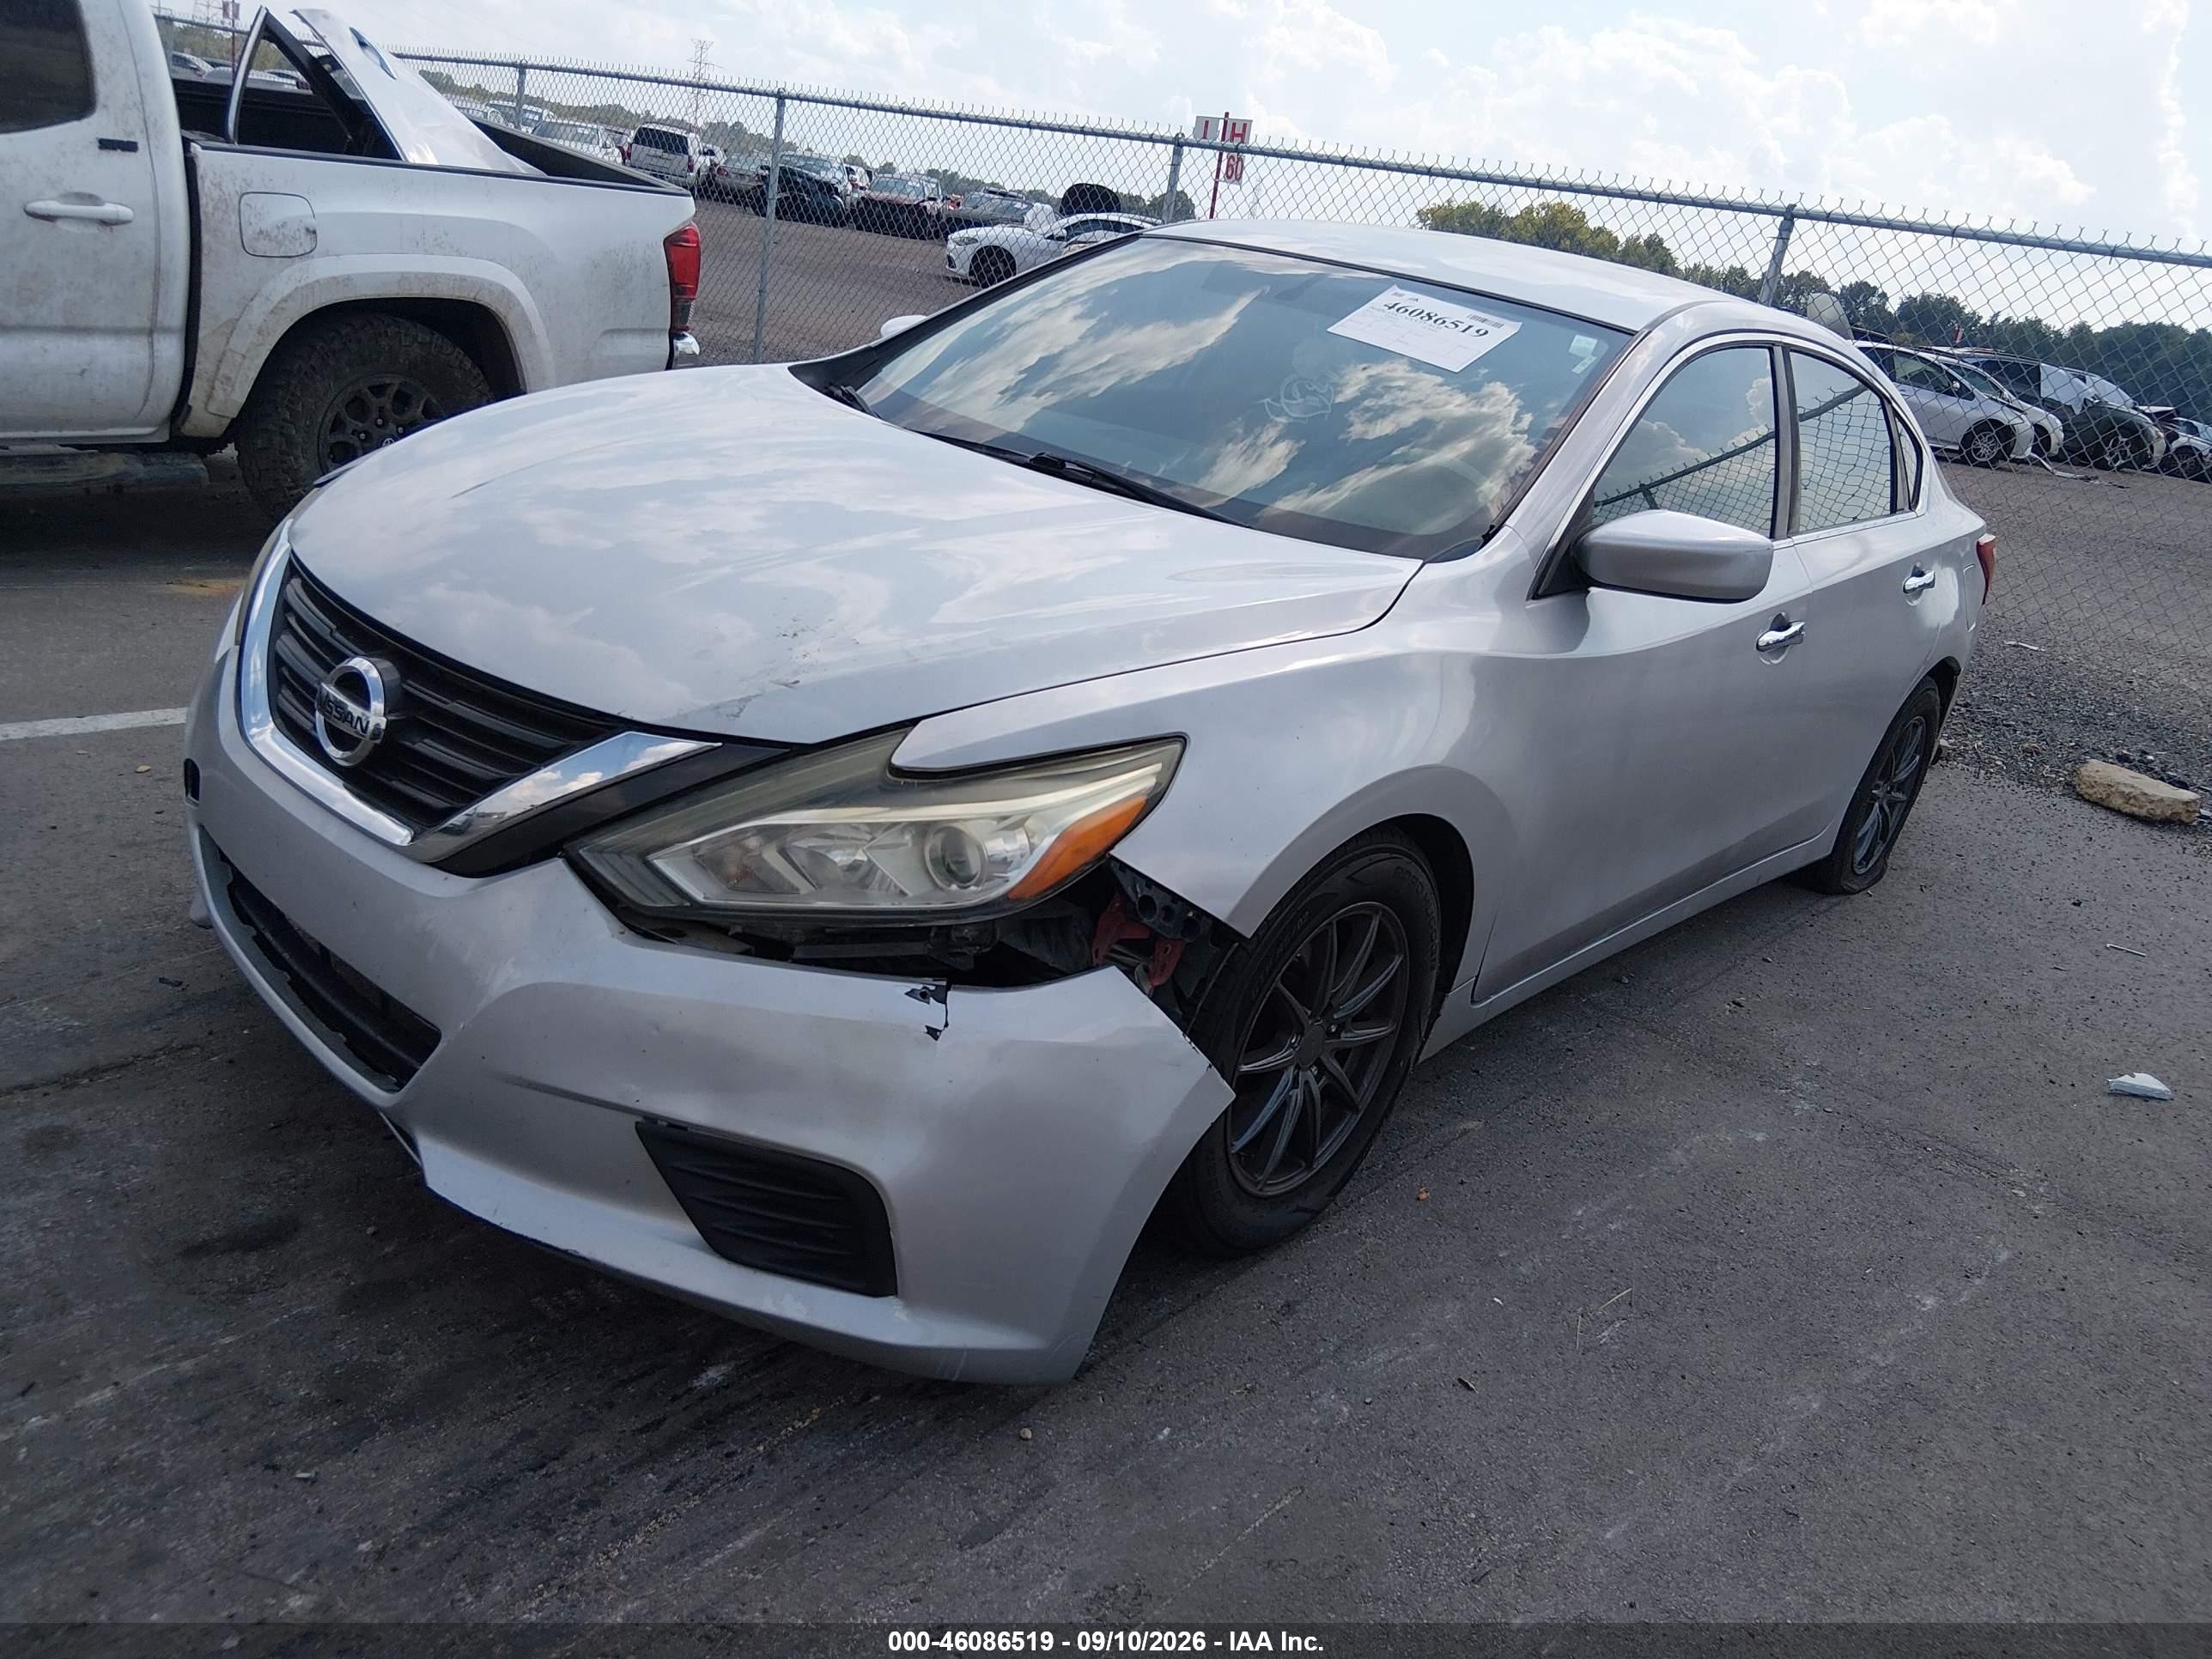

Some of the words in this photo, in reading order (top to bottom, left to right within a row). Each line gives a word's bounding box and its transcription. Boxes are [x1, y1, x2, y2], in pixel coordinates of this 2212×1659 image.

[1230, 122, 1248, 143] H
[1225, 155, 1244, 181] 60
[1383, 301, 1490, 337] 46086519
